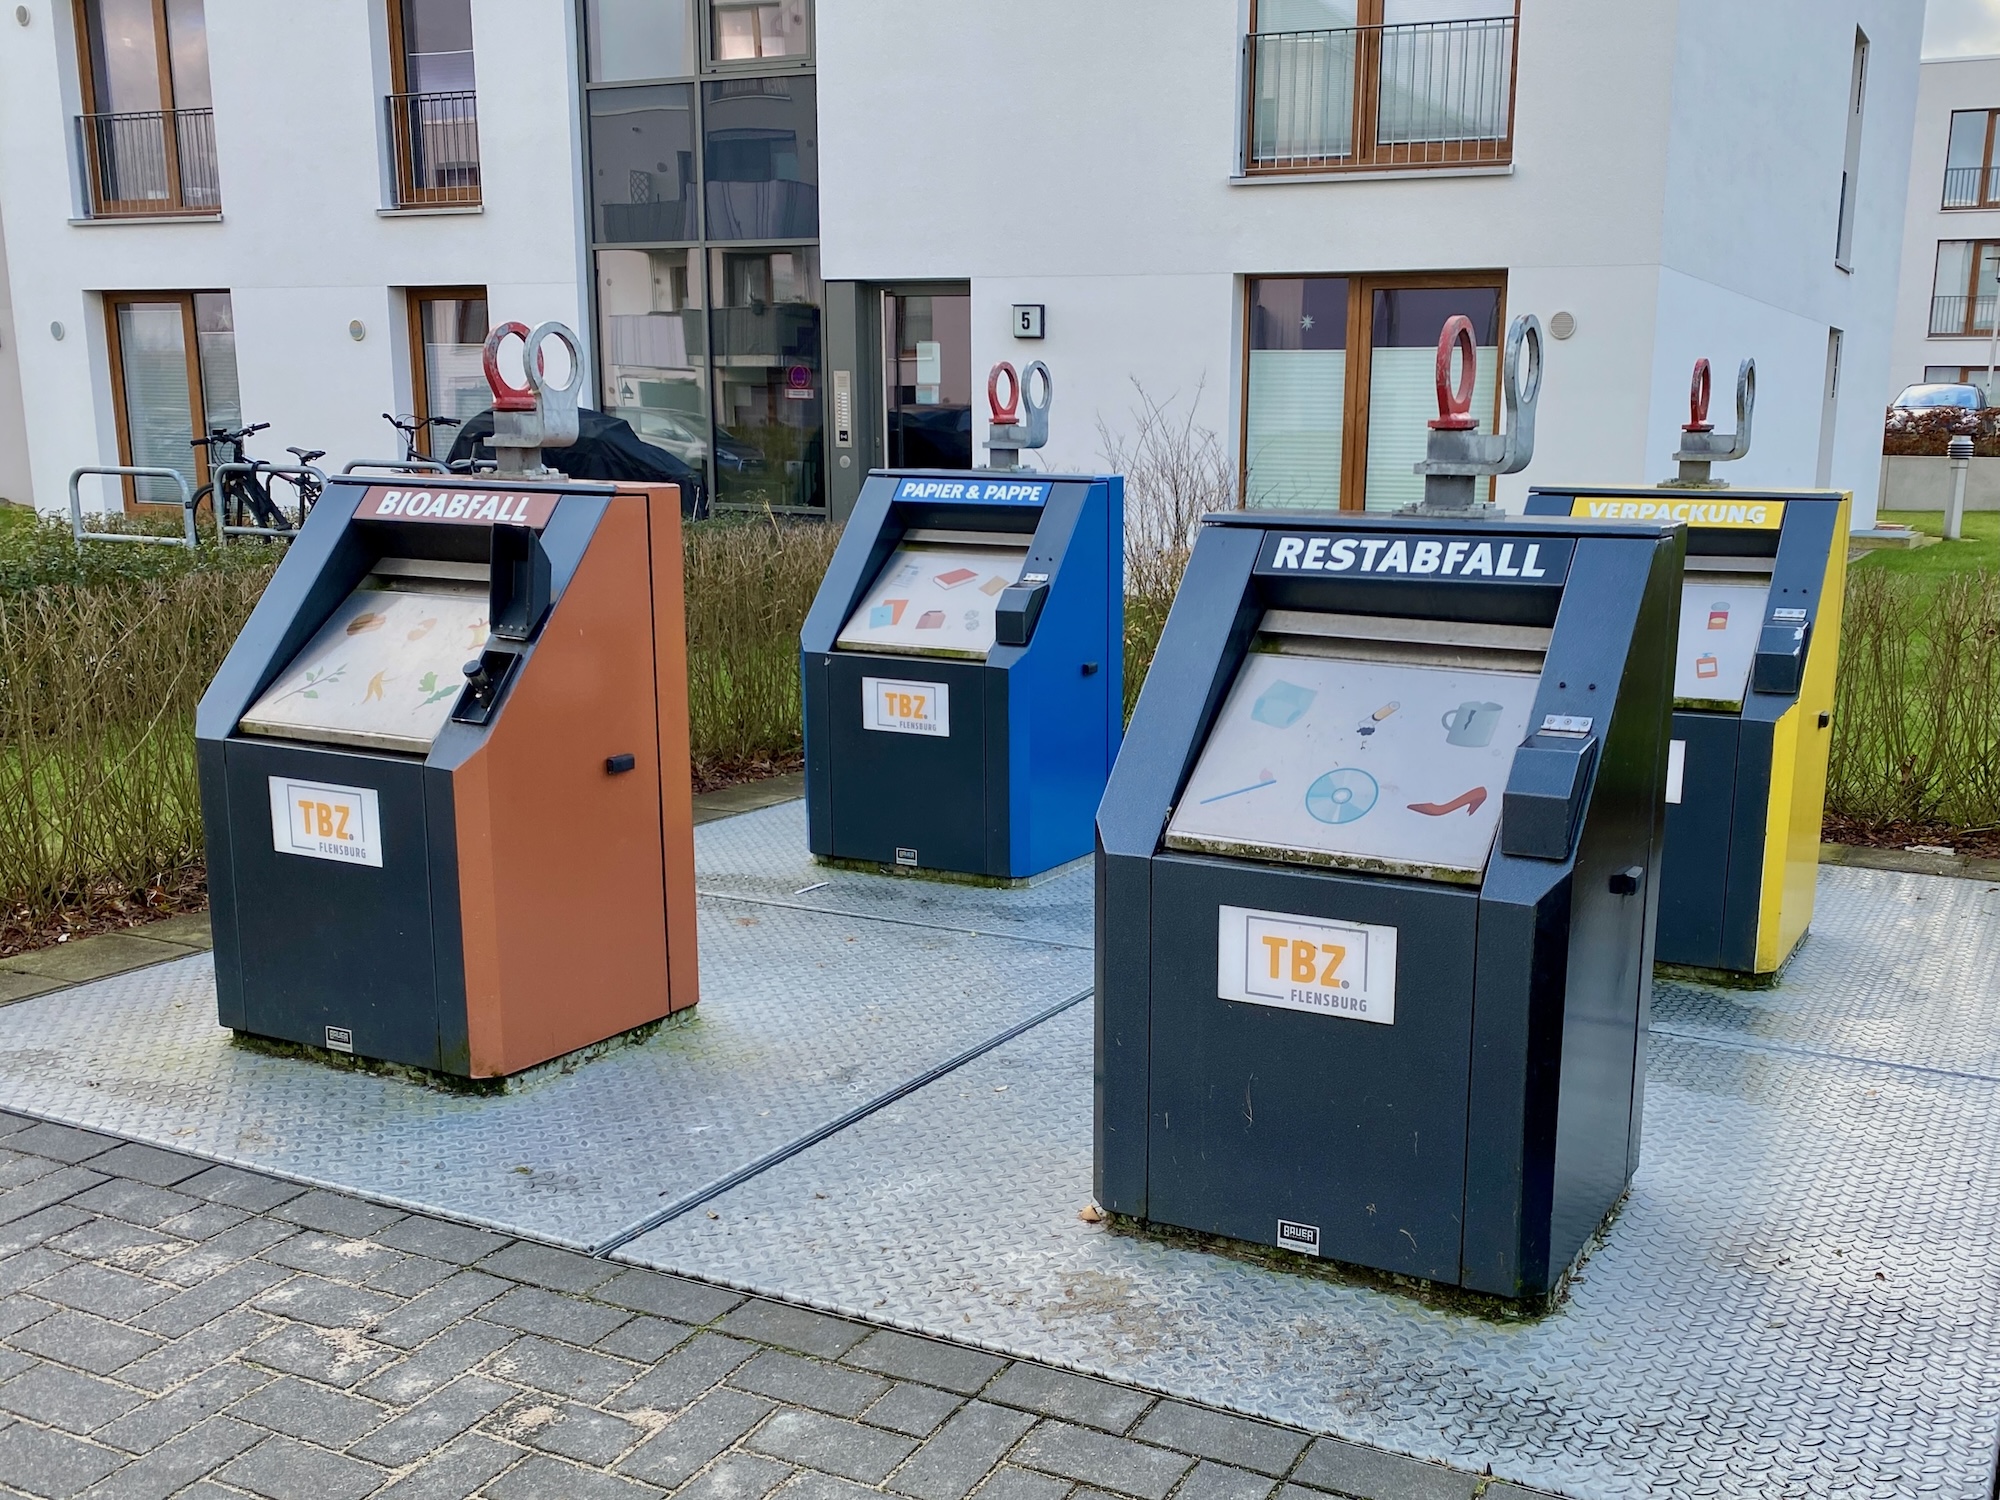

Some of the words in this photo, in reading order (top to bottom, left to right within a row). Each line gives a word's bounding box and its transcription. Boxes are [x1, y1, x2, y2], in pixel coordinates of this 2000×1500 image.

[1021, 311, 1030, 330] 5
[901, 482, 965, 499] PAPIER
[965, 484, 980, 500] &
[983, 485, 1043, 501] PAPPE
[375, 491, 530, 522] BIOABFALL
[1588, 501, 1767, 524] VERPACKUNG
[1271, 537, 1547, 578] RESTABFALL
[899, 720, 937, 732] FLENSBURG
[318, 842, 367, 859] FLENSBURG
[1290, 988, 1367, 1012] FLENSBURG
[1283, 1224, 1314, 1243] BAUER
